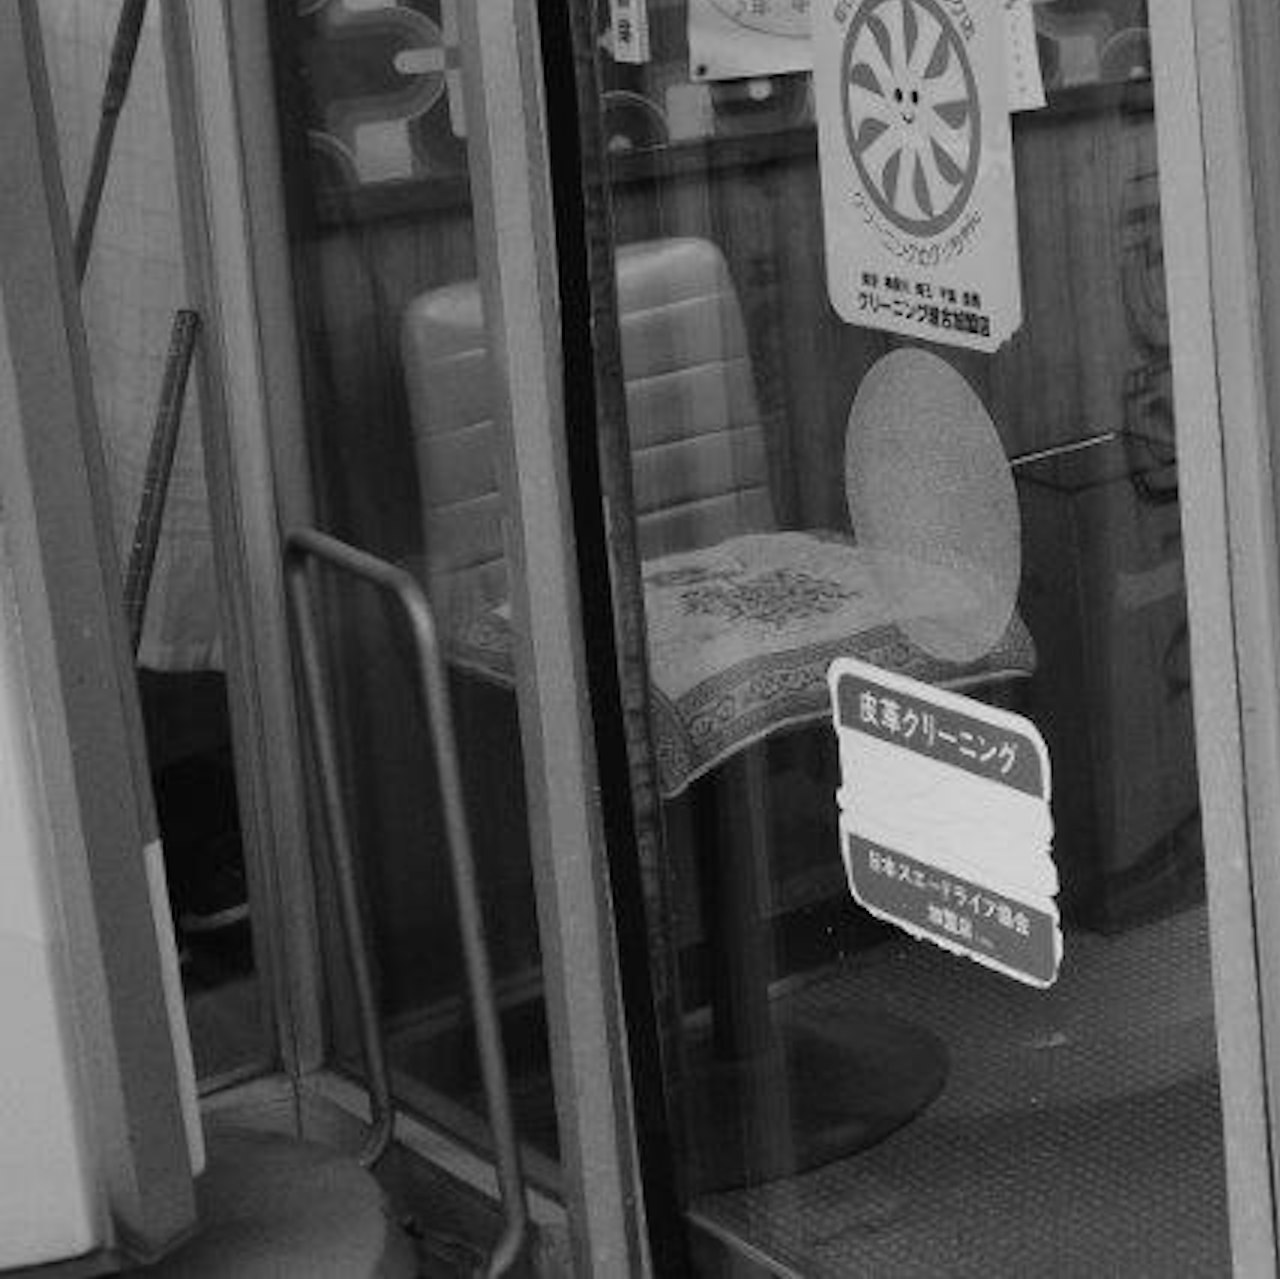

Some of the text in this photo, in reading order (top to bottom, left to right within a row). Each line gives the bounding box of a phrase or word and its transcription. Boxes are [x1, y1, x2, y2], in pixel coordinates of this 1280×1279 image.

[860, 690, 1019, 774] 皮革クリーニング
